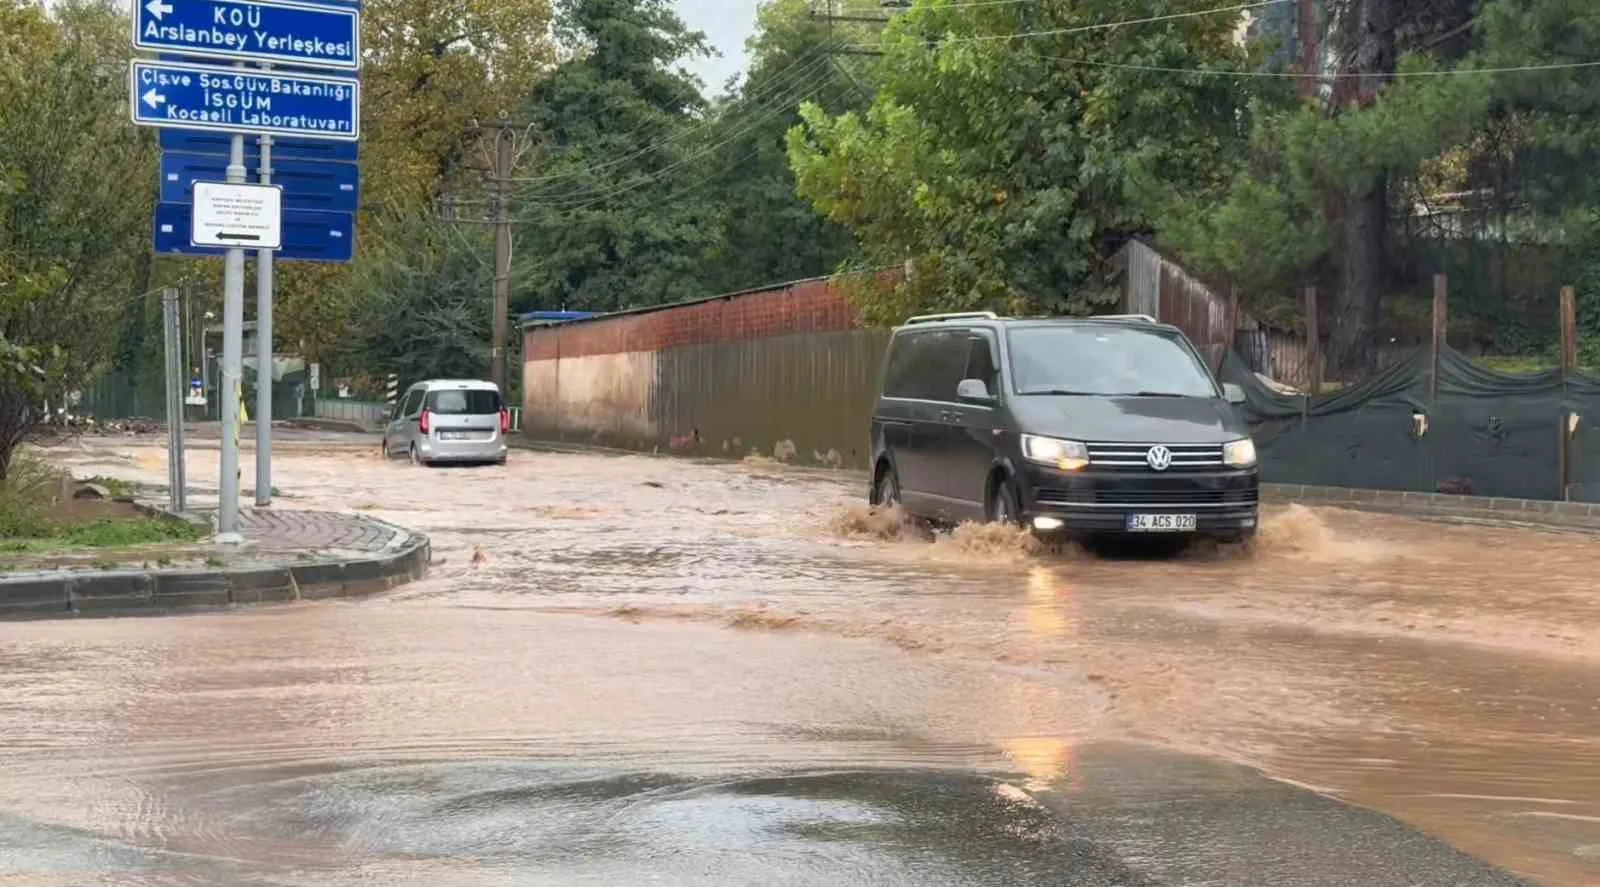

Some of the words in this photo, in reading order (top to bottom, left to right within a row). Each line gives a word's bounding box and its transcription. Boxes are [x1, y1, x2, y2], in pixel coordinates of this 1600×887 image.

[213, 6, 261, 28] KOÜ
[144, 20, 248, 50] Arslanbey
[253, 31, 351, 57] Yerleşkesi
[241, 109, 350, 131] Laboratuvarı
[1152, 515, 1171, 528] ACS
